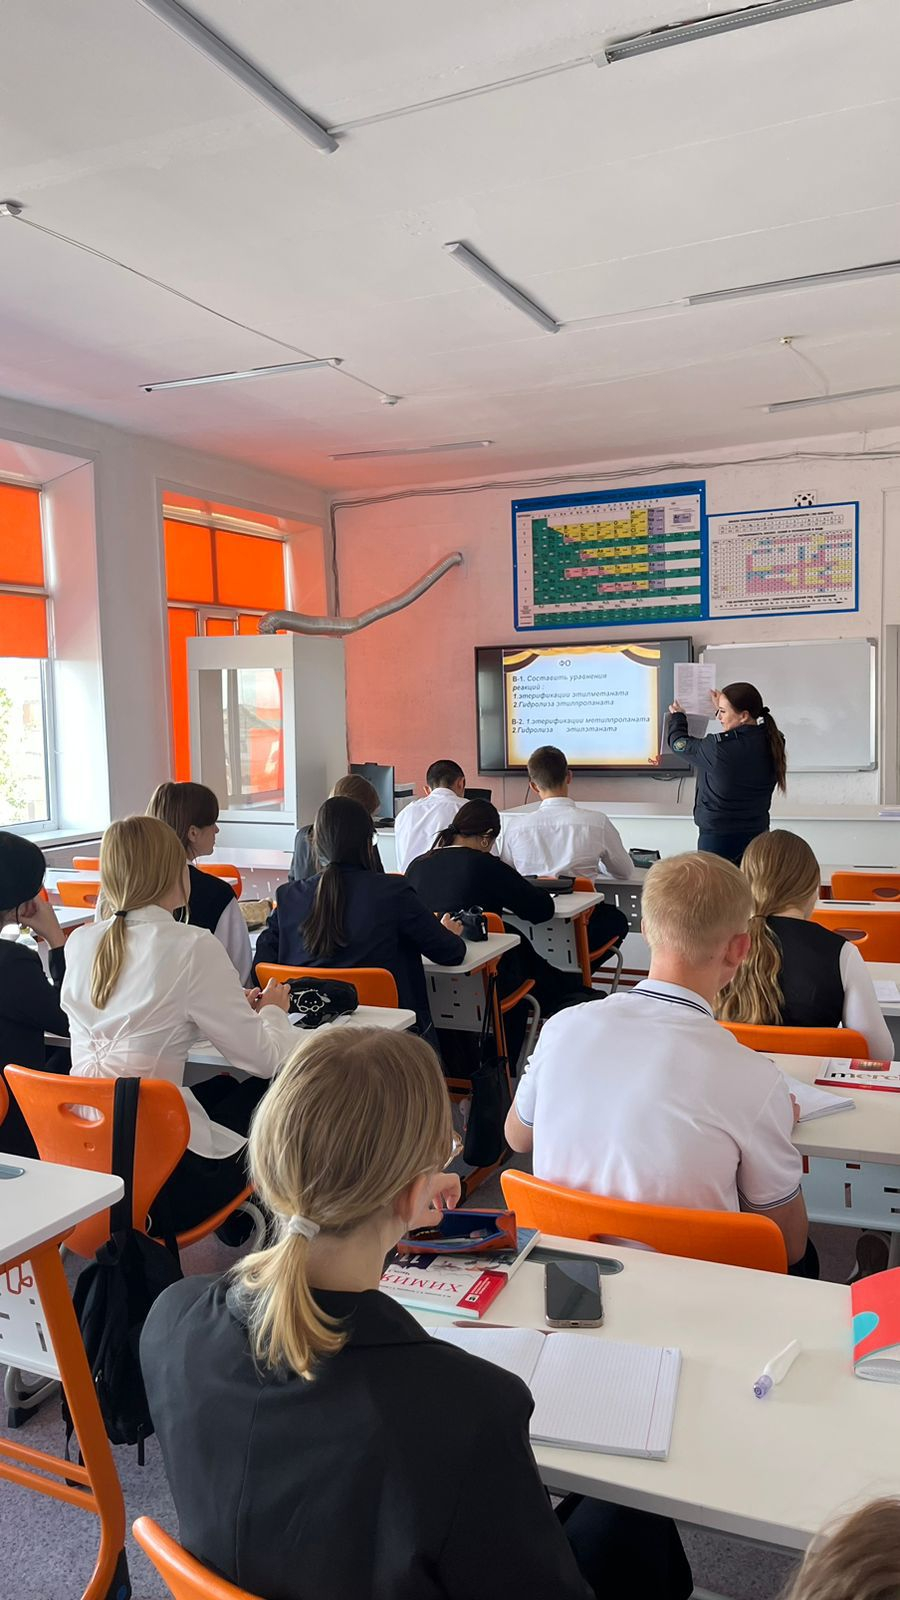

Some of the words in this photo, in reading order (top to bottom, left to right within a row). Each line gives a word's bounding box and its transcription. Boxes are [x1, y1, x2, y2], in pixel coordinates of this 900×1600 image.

[527, 674, 569, 682] Составить
[569, 673, 608, 682] уравнения
[512, 683, 541, 692] реакций
[585, 716, 651, 725] метилпропаната
[381, 1274, 463, 1293] ХИМИЯ
